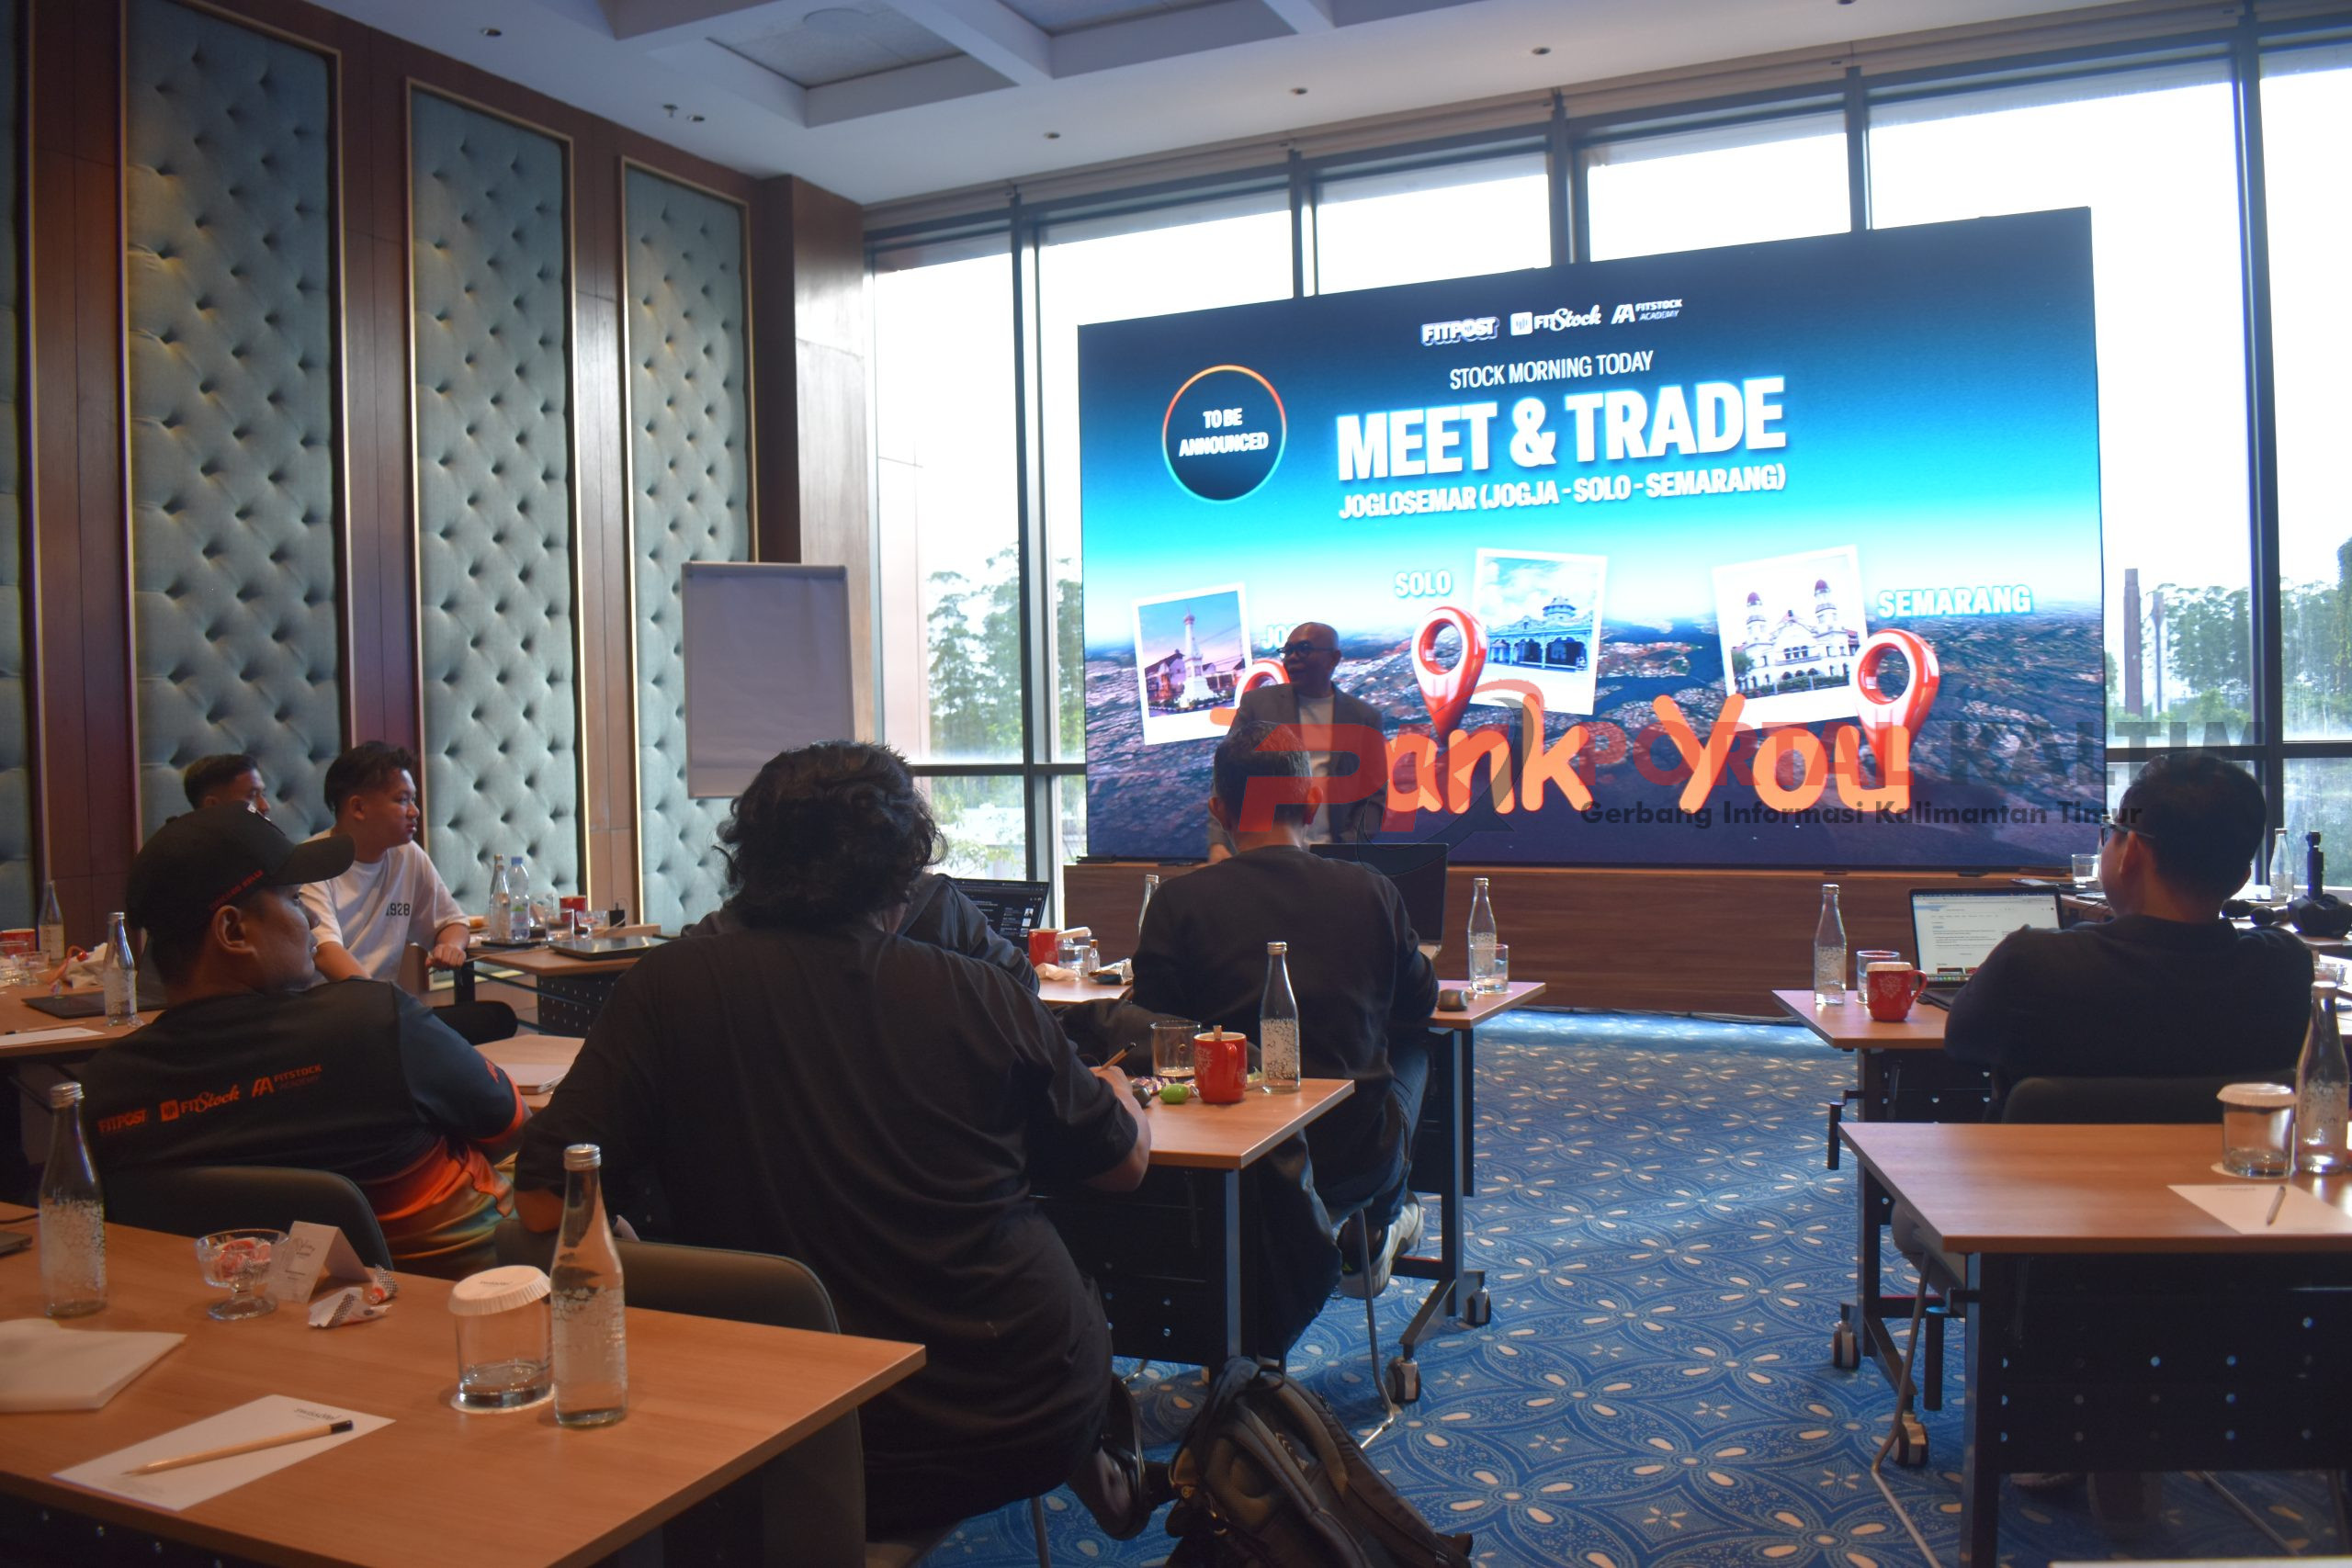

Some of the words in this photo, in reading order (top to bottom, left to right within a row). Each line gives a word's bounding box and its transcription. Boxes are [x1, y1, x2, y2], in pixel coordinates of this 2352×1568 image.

[1634, 299, 1683, 312] FITSTOCK
[1638, 310, 1679, 321] ACADEMY
[1421, 316, 1499, 346] FITPOST
[1450, 365, 1505, 390] STOCK
[1509, 355, 1592, 384] MORNING
[1596, 350, 1654, 374] TODAY
[1203, 410, 1223, 429] TO
[1223, 408, 1243, 427] BE
[1336, 401, 1498, 481] MEET
[1510, 397, 1556, 467] &
[1565, 377, 1787, 463] TRADE
[1179, 432, 1269, 457] ANNOUNCED
[1339, 484, 1477, 520] JOGLOSEMAR
[1479, 479, 1559, 510] (JOGJA
[1574, 474, 1632, 503] SOLO
[1645, 463, 1787, 498] SEMARANG)
[1395, 570, 1452, 598] SOLO
[1877, 584, 2032, 619] SEMARANG
[1652, 693, 1911, 815] You
